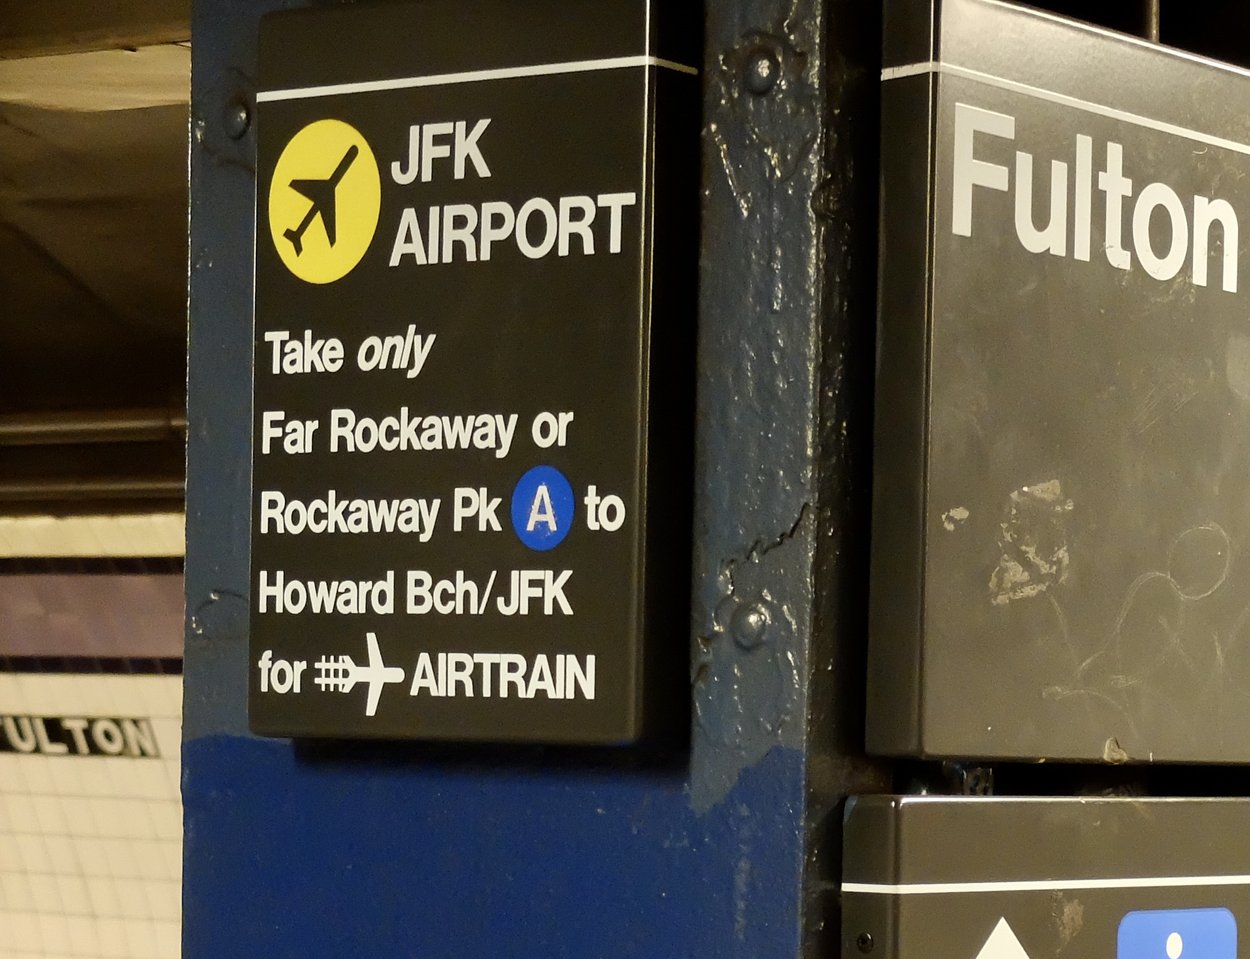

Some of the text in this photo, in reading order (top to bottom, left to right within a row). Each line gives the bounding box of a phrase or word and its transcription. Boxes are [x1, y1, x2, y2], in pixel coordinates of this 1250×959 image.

[390, 118, 492, 185] JFK
[950, 102, 1239, 294] Fulton
[388, 191, 637, 267] AIRPORT
[264, 323, 437, 379] Take only
[261, 406, 574, 459] Far Rockaway or
[260, 484, 626, 543] Rockaway Pk A to
[258, 569, 574, 616] Howard Bch/JFK
[257, 649, 596, 700] for AIRTRAIN
[0, 716, 159, 757] ULTON
